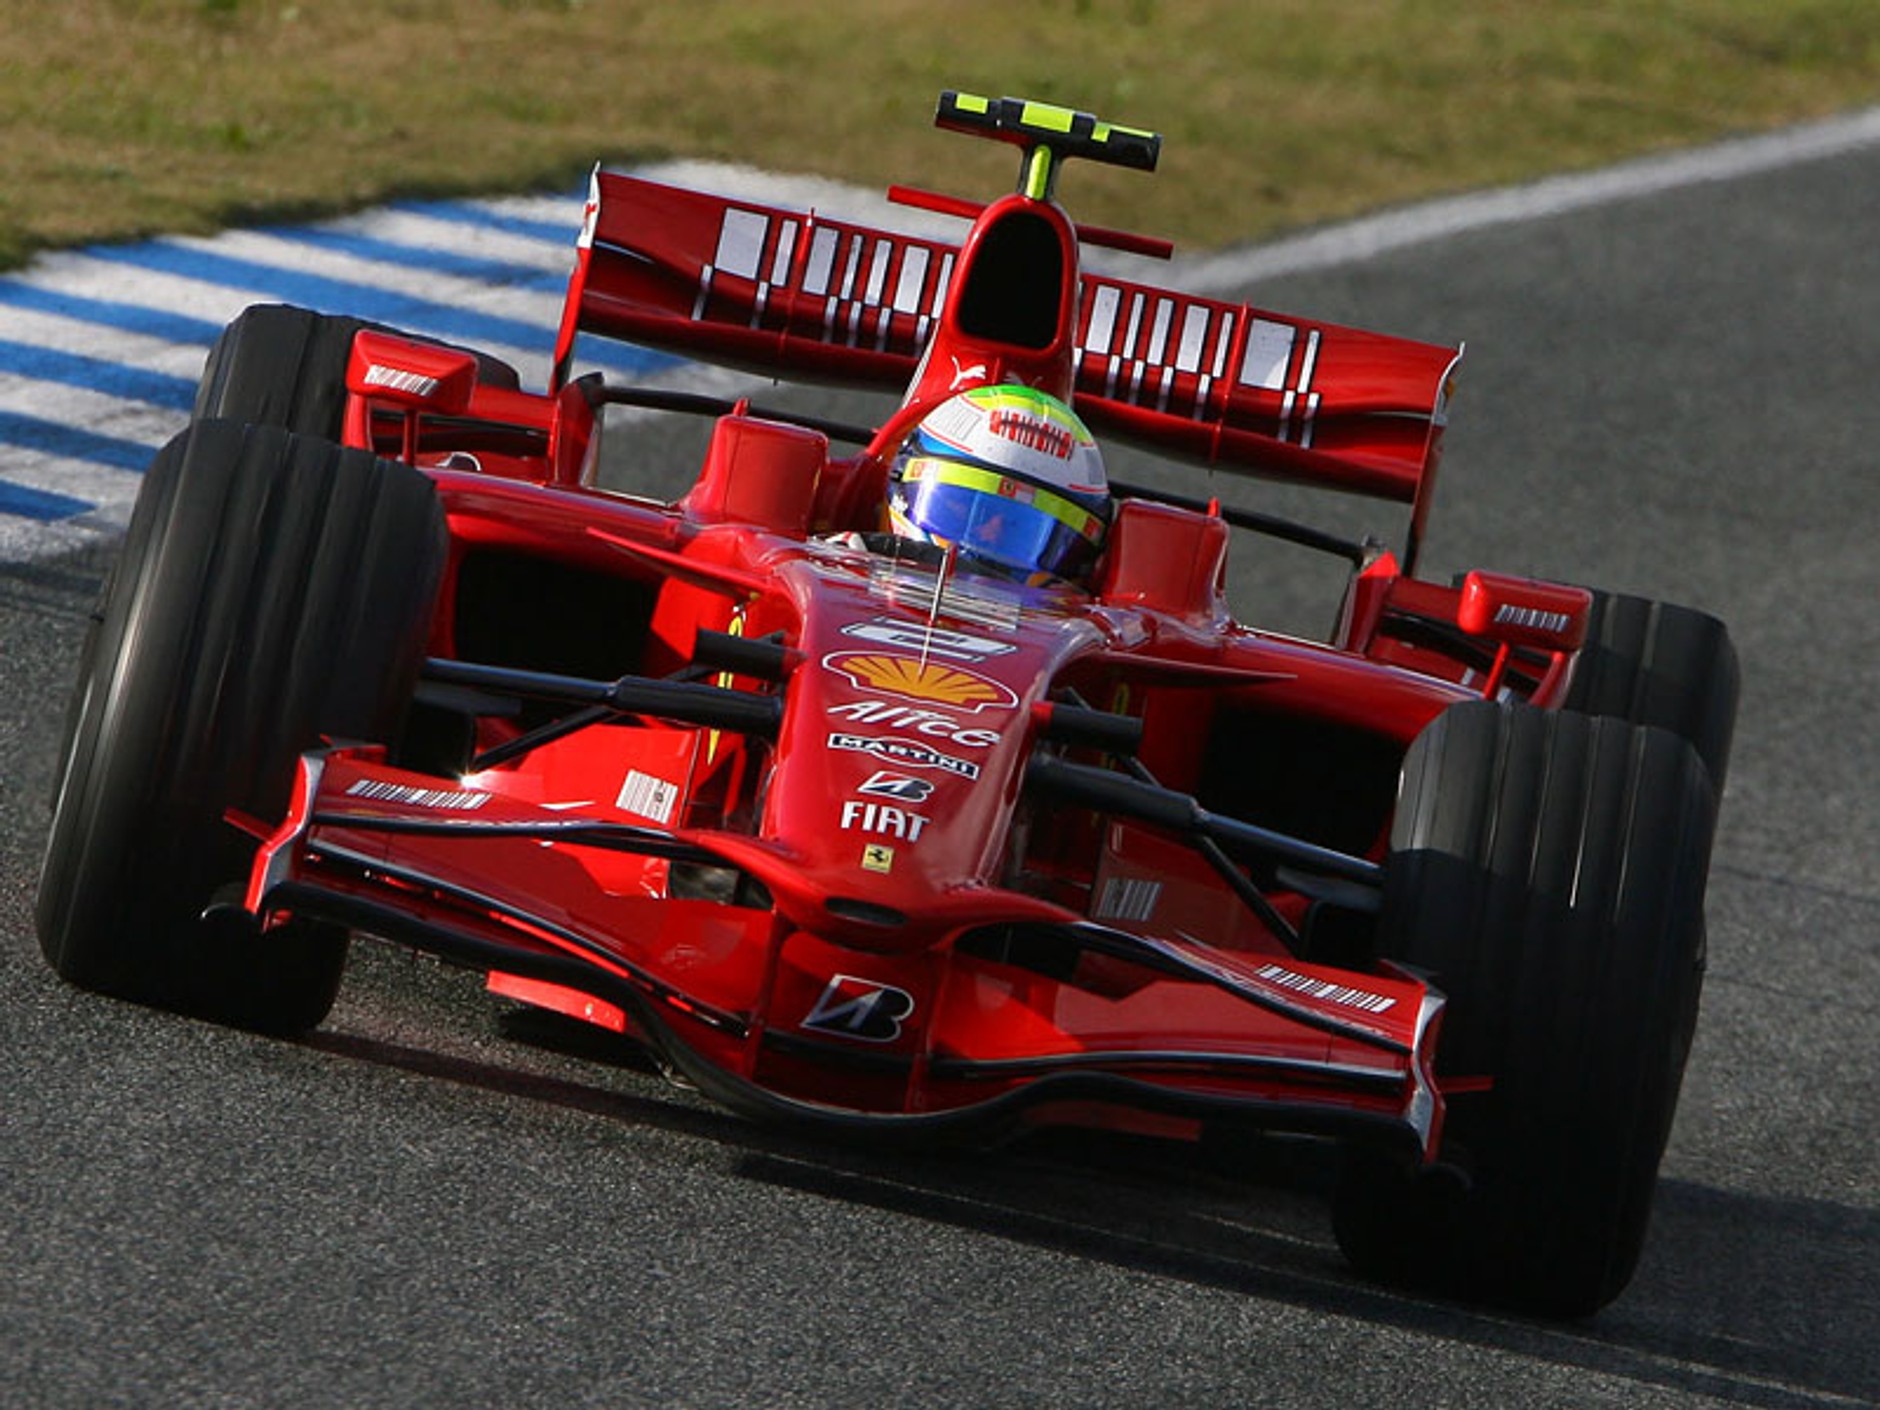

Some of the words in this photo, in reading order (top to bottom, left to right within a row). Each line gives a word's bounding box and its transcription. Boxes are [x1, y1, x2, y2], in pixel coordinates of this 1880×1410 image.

[826, 701, 1001, 747] Alice
[838, 736, 969, 775] MARTINI
[840, 801, 930, 843] FIAT
